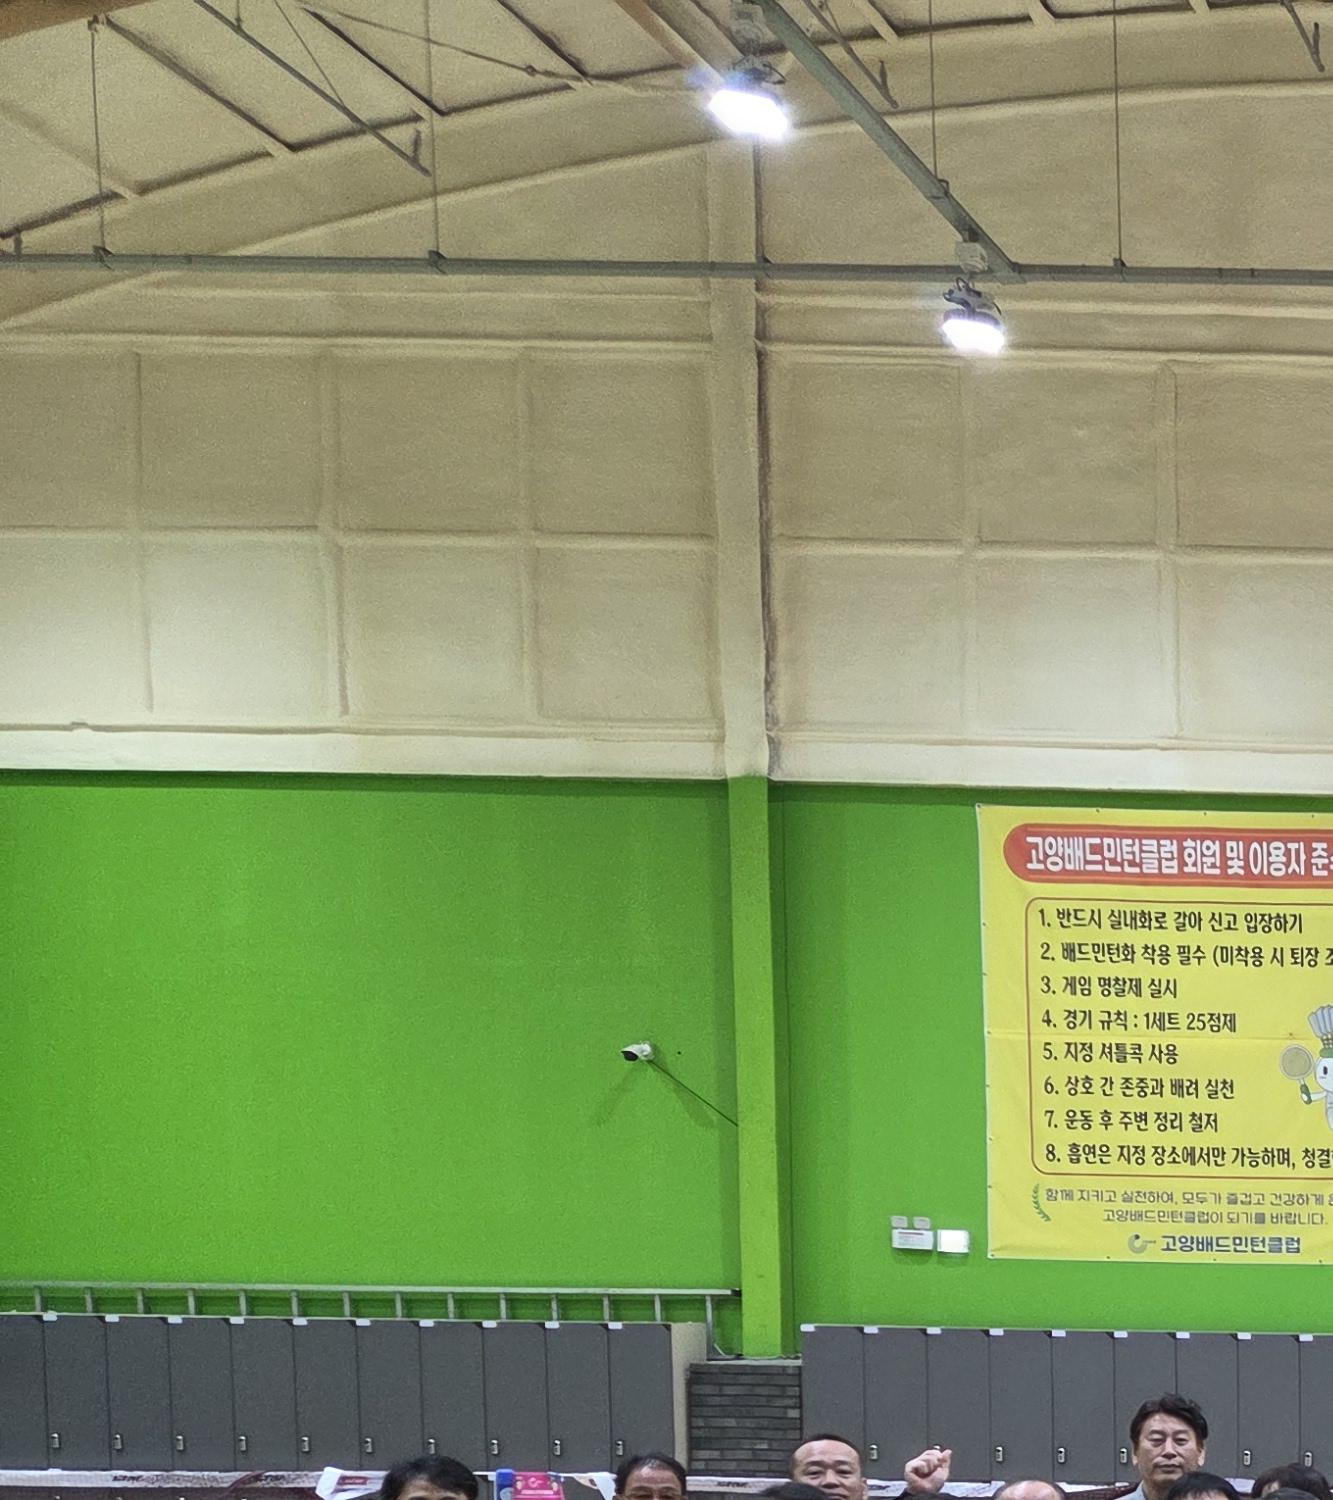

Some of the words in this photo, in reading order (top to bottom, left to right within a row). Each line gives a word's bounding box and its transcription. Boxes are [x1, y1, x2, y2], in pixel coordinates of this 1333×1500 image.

[1026, 836, 1178, 874] 고양배드민턴클럽
[1183, 838, 1220, 874] 회원
[1226, 841, 1244, 875] 및
[1249, 841, 1306, 876] 이용자
[1039, 908, 1051, 927] 1.
[1056, 908, 1101, 929] 반드시
[1108, 909, 1168, 931] 실내화로
[1174, 912, 1202, 932] 갈아
[1209, 912, 1238, 932] 신고
[1244, 913, 1302, 934] 입장하기
[1041, 942, 1055, 961] 2.
[1061, 943, 1136, 964] 배드민턴화
[1141, 944, 1171, 965] 착용
[1177, 945, 1206, 965] 필수
[1213, 945, 1264, 967] (미착용
[1271, 947, 1283, 967] 시
[1290, 947, 1319, 968] 퇴장
[1041, 976, 1056, 994] 3.
[1063, 976, 1091, 996] 게임
[1098, 976, 1142, 997] 명찰제
[1148, 978, 1177, 998] 실시
[1042, 1009, 1056, 1028] 4.
[1064, 1010, 1092, 1030] 경기
[1099, 1010, 1127, 1031] 규칙
[1144, 1012, 1180, 1031] 1세트
[1187, 1013, 1236, 1032] 25점제
[1043, 1042, 1057, 1060] 5.
[1064, 1042, 1093, 1063] 지정
[1099, 1043, 1143, 1064] 셔틀콕
[1149, 1044, 1178, 1065] 사용
[1044, 1076, 1059, 1094] 6.
[1065, 1075, 1094, 1096] 상호
[1101, 1077, 1114, 1096] 간
[1120, 1077, 1164, 1098] 존중과
[1170, 1079, 1198, 1098] 배려
[1205, 1079, 1234, 1099] 실천
[1045, 1110, 1057, 1128] 7.
[1065, 1110, 1093, 1130] 운동
[1100, 1110, 1113, 1130] 후
[1119, 1111, 1148, 1131] 주변
[1154, 1112, 1182, 1132] 정리
[1189, 1112, 1217, 1132] 철저
[1046, 1144, 1060, 1162] 8.
[1068, 1143, 1111, 1164] 흡연은
[1118, 1145, 1145, 1165] 지정
[1152, 1146, 1226, 1167] 장소에서만
[1232, 1147, 1295, 1170] 가능하며,
[1122, 1191, 1177, 1205] 실천하여,
[1182, 1192, 1221, 1204] 모두가
[1270, 1193, 1324, 1206] 건강하게
[1104, 1210, 1223, 1224] 고양배드민턴클럽이
[1271, 1212, 1328, 1226] 바랍니다.
[1161, 1236, 1300, 1253] 고양배드민턴클럽
